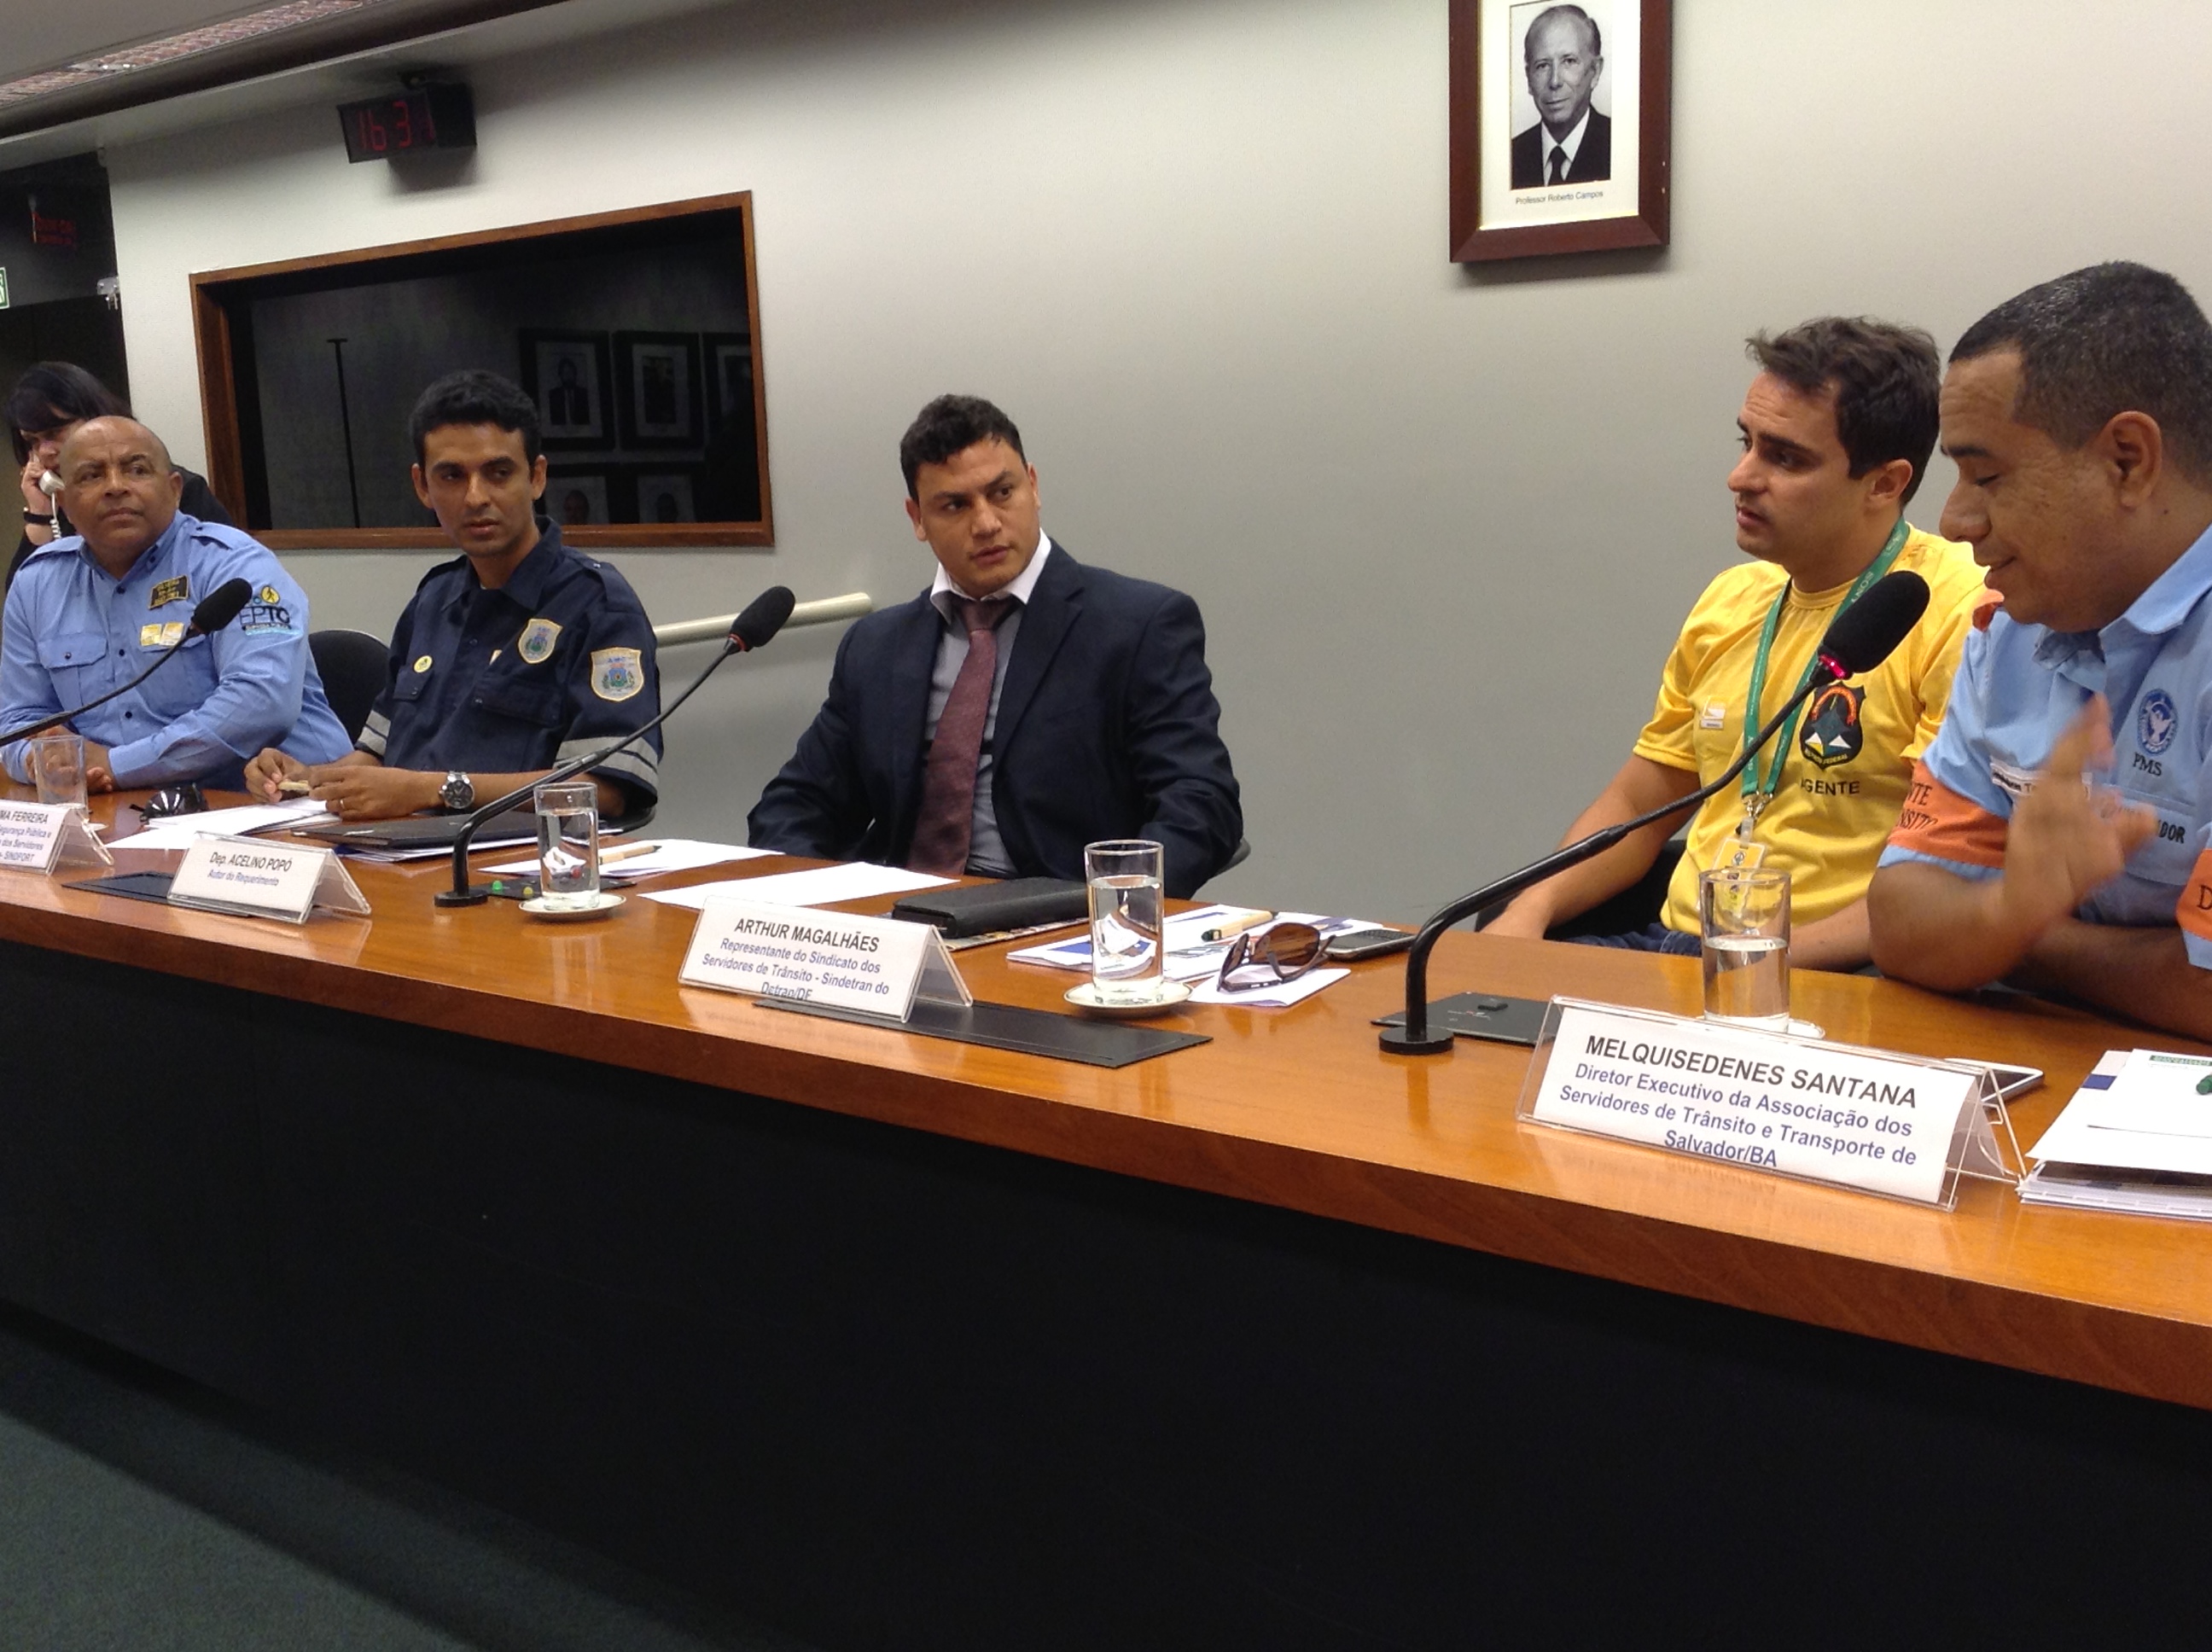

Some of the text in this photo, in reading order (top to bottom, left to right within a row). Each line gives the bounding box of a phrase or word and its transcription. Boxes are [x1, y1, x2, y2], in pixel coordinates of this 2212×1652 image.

[1547, 193, 1574, 201] Roberto
[1575, 191, 1604, 200] Campos
[2133, 752, 2163, 777] PMS
[12, 811, 49, 823] FERREIRA
[2158, 819, 2186, 844] DOR
[207, 870, 279, 886] Autor do Requerimento
[209, 852, 293, 872] Dep. ACELINO POPÓ
[734, 918, 880, 953] ARTHUR MAGALHÃES
[720, 938, 882, 974] Representante do Sindicato dos
[701, 953, 754, 973] Servidores
[756, 962, 768, 974] de
[771, 963, 812, 982] Trânsito
[821, 972, 872, 992] Sindetran
[875, 981, 889, 995] do
[1586, 1035, 1916, 1108] MELQUISEDENES SANTANA
[1575, 1062, 1912, 1137] Diretor Executivo da Associação dos
[1560, 1085, 1917, 1166] Servidores de Trânsito e Transporte de
[1664, 1130, 1777, 1167] Salvador/BA
